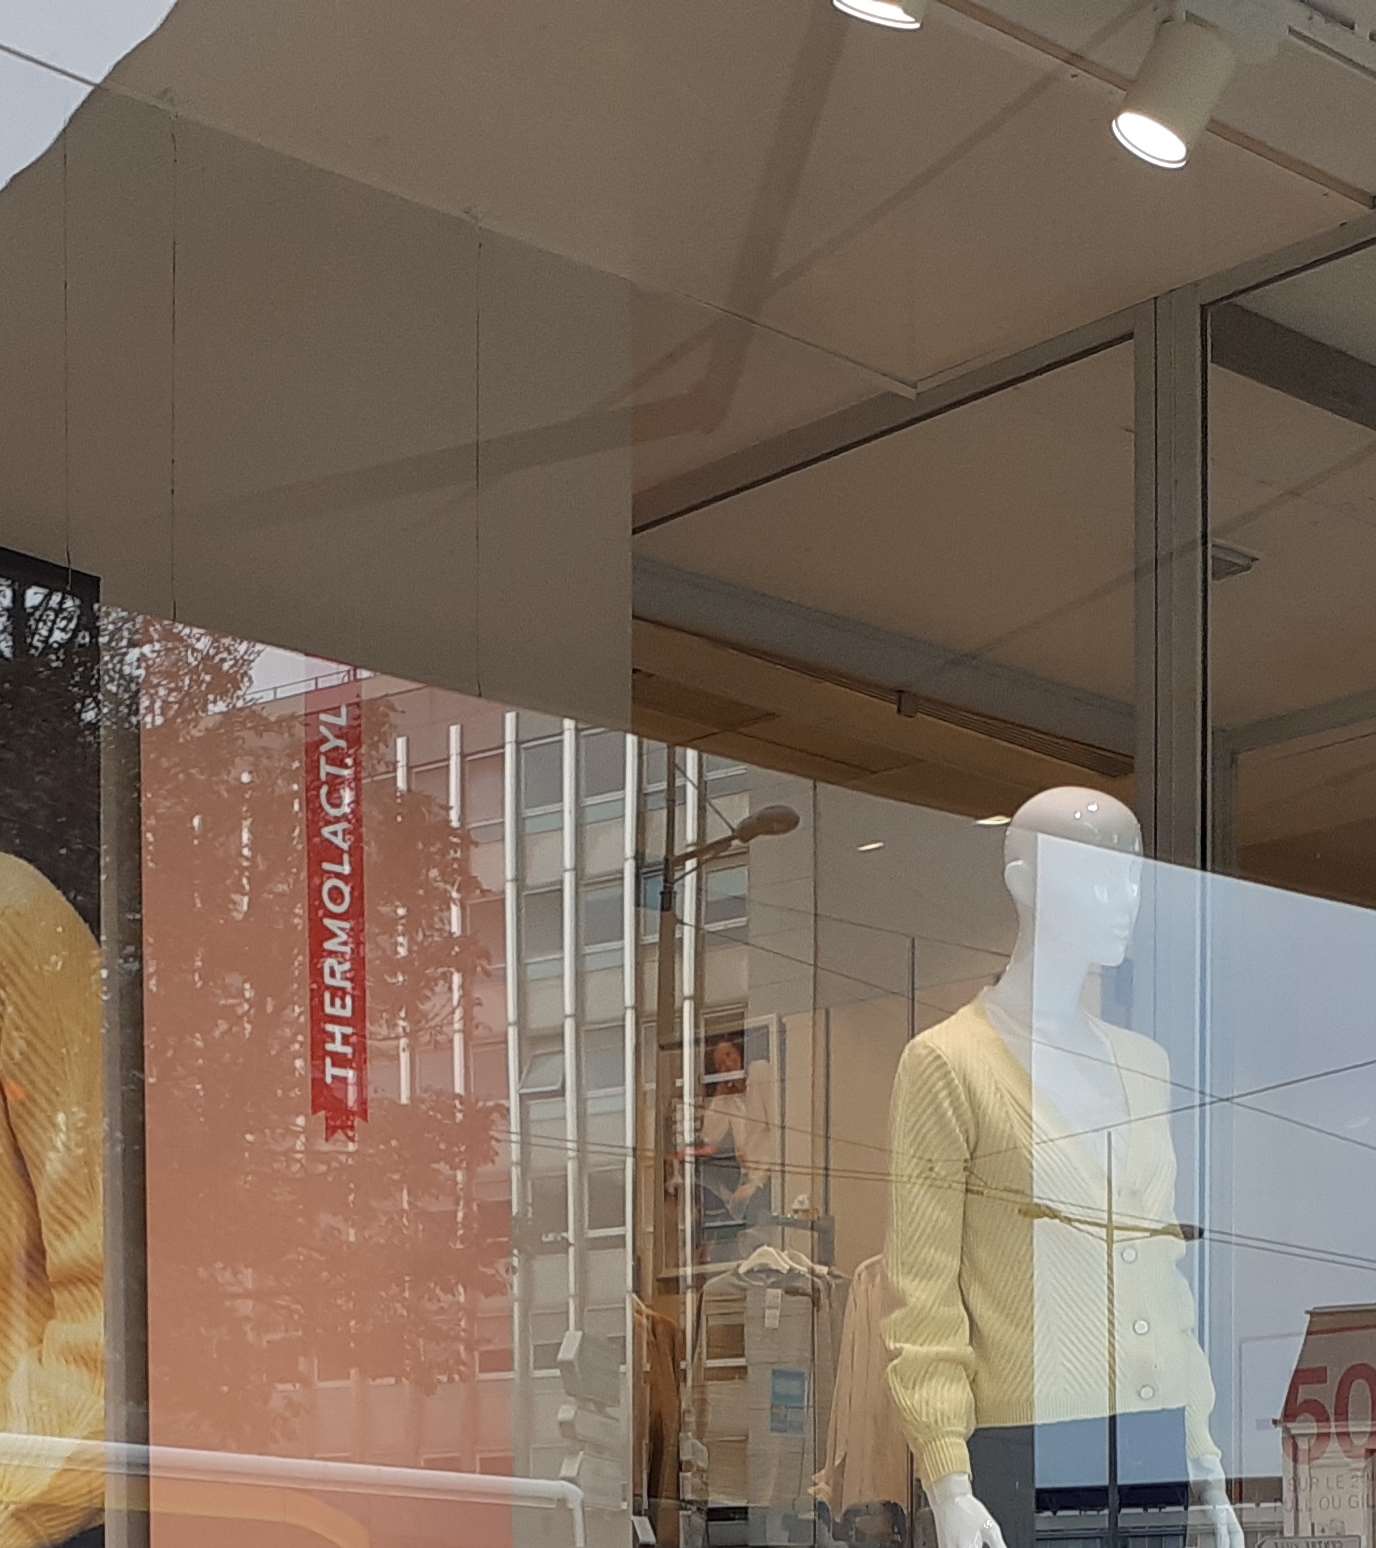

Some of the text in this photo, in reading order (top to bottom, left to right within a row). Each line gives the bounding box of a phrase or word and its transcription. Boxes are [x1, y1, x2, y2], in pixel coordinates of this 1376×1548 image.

[319, 704, 356, 1085] THERMOLACTYL
[1327, 1475, 1344, 1489] LE
[1319, 1494, 1342, 1509] OU
